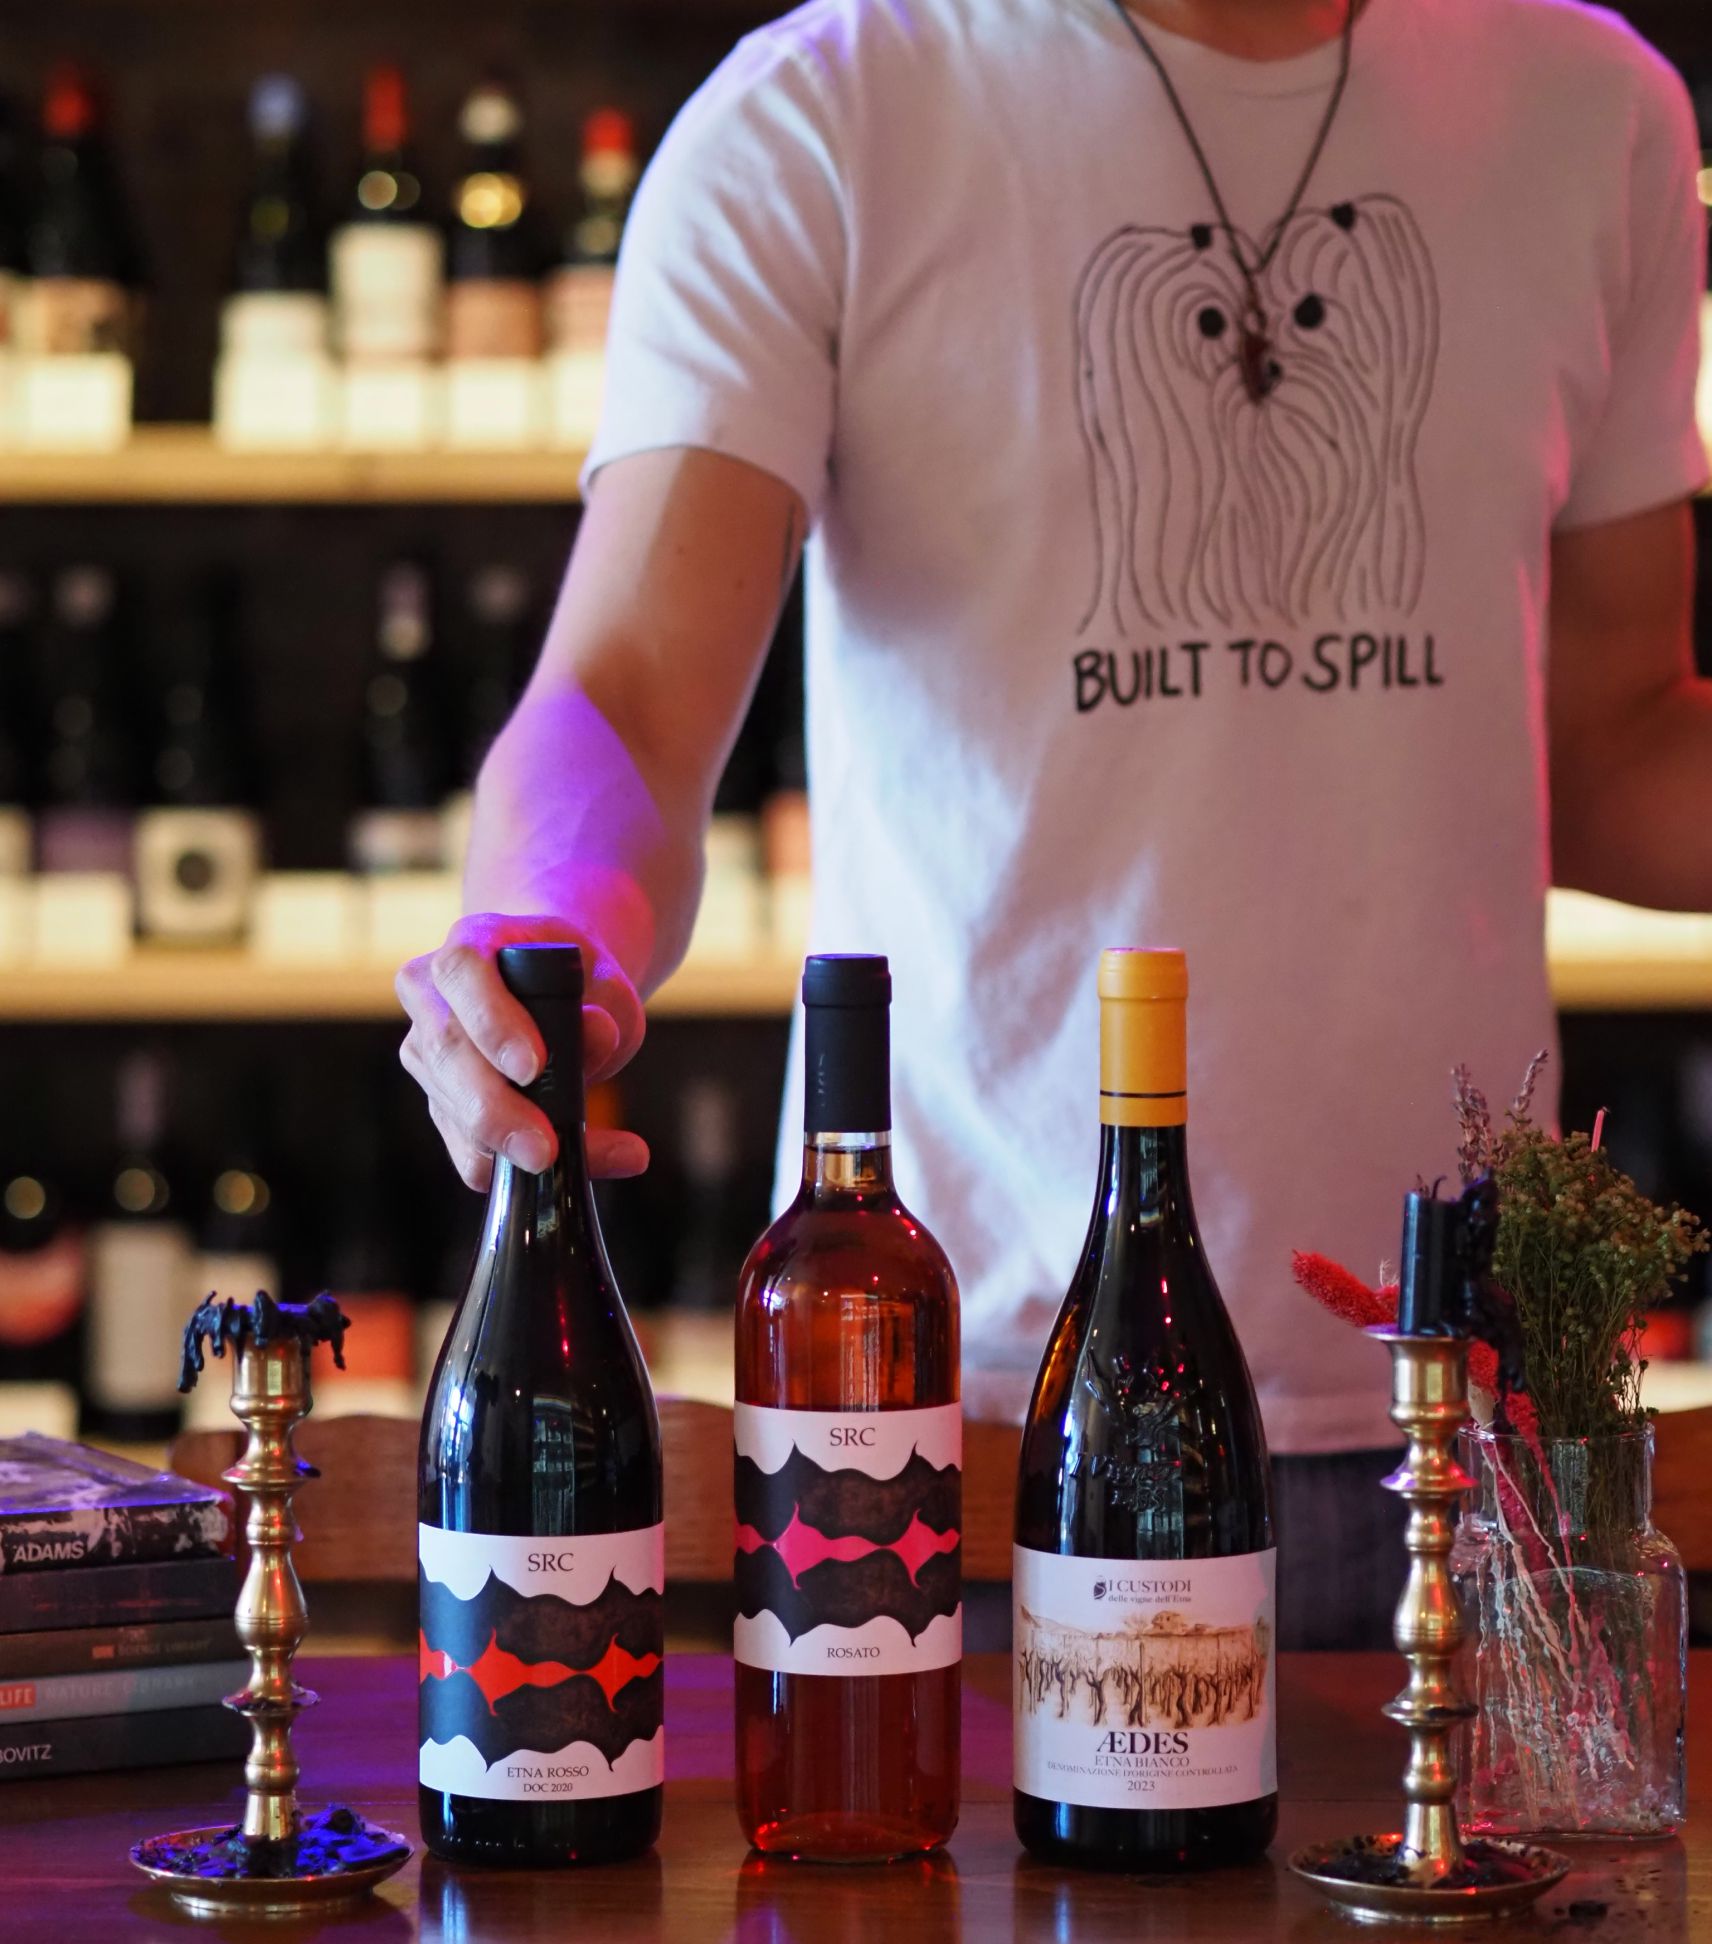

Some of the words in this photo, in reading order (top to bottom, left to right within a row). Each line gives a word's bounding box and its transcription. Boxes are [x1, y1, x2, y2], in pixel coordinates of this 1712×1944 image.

[1074, 641, 1210, 713] BUILT
[1228, 639, 1293, 688] TO
[1304, 633, 1444, 692] SPILL
[829, 1427, 876, 1447] SRC
[13, 1541, 85, 1563] ADAMS
[527, 1552, 574, 1572] SRC
[1117, 1579, 1192, 1592] CUSTODI
[826, 1647, 881, 1658] ROSATO
[1096, 1731, 1189, 1754] ÆDES
[1094, 1755, 1132, 1767] ETNA
[1135, 1756, 1190, 1767] BIANCO
[507, 1767, 543, 1778] ETNA
[547, 1766, 589, 1777] ROSSO
[523, 1784, 549, 1793] DOC
[551, 1782, 573, 1793] 2020
[1127, 1780, 1156, 1792] 2023
